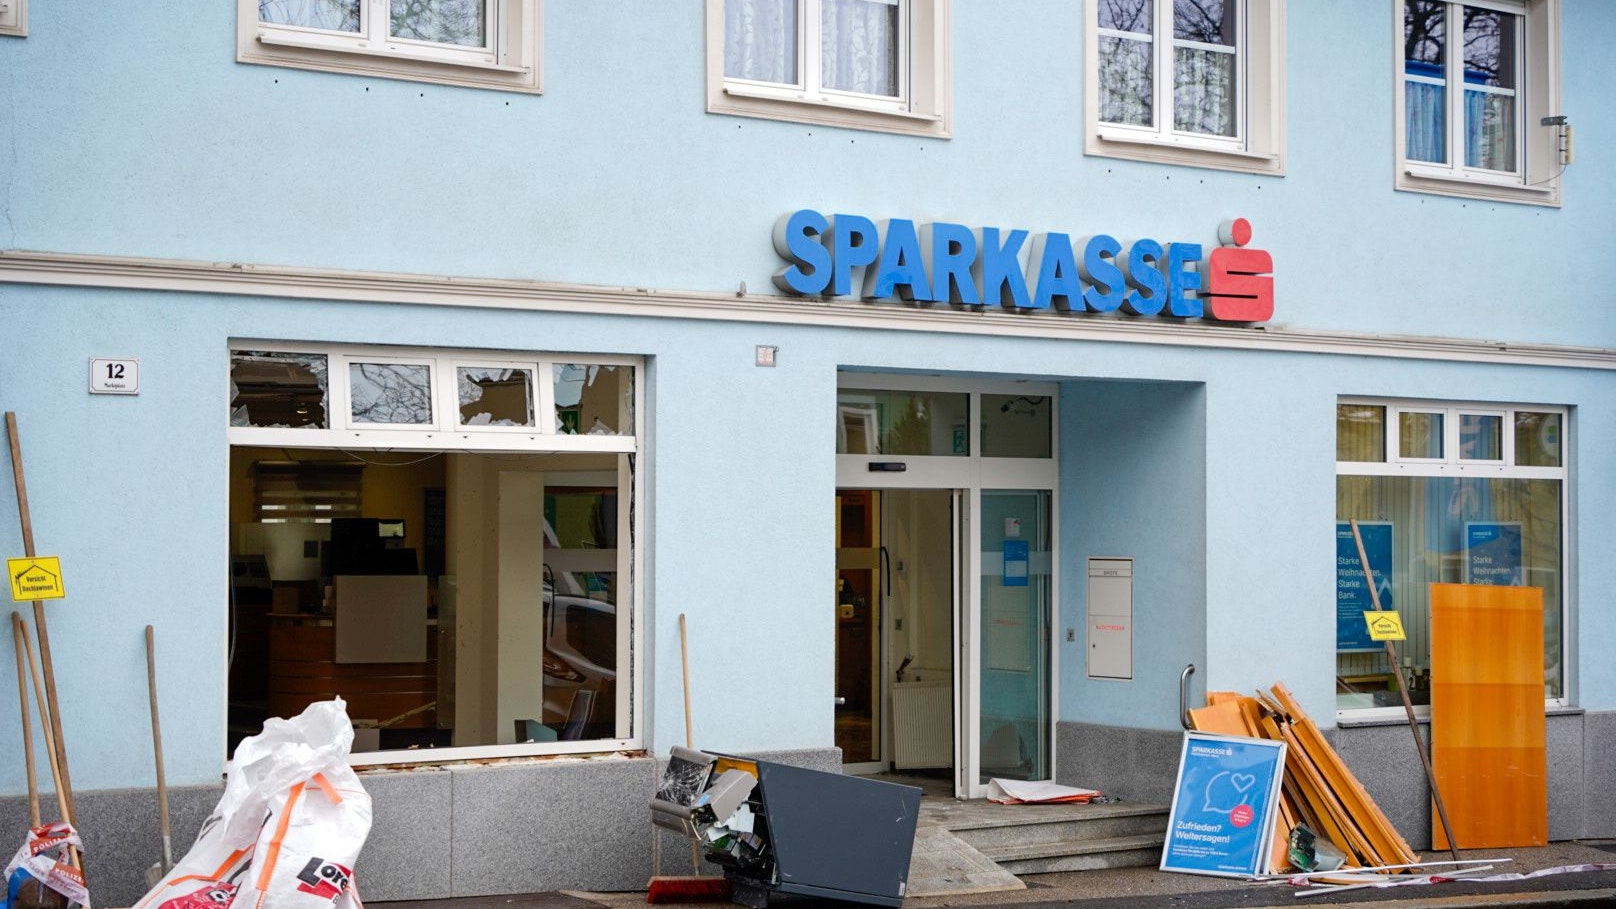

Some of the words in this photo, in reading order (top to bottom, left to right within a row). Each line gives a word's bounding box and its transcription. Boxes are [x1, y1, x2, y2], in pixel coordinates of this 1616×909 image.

[774, 208, 1203, 319] SPARKASSE
[106, 363, 125, 379] 12
[1337, 556, 1360, 565] Starke
[1338, 579, 1361, 588] Starke
[1338, 591, 1357, 600] Bank.
[1177, 820, 1222, 833] Zufrieden?
[1175, 830, 1230, 844] Weitersagen!
